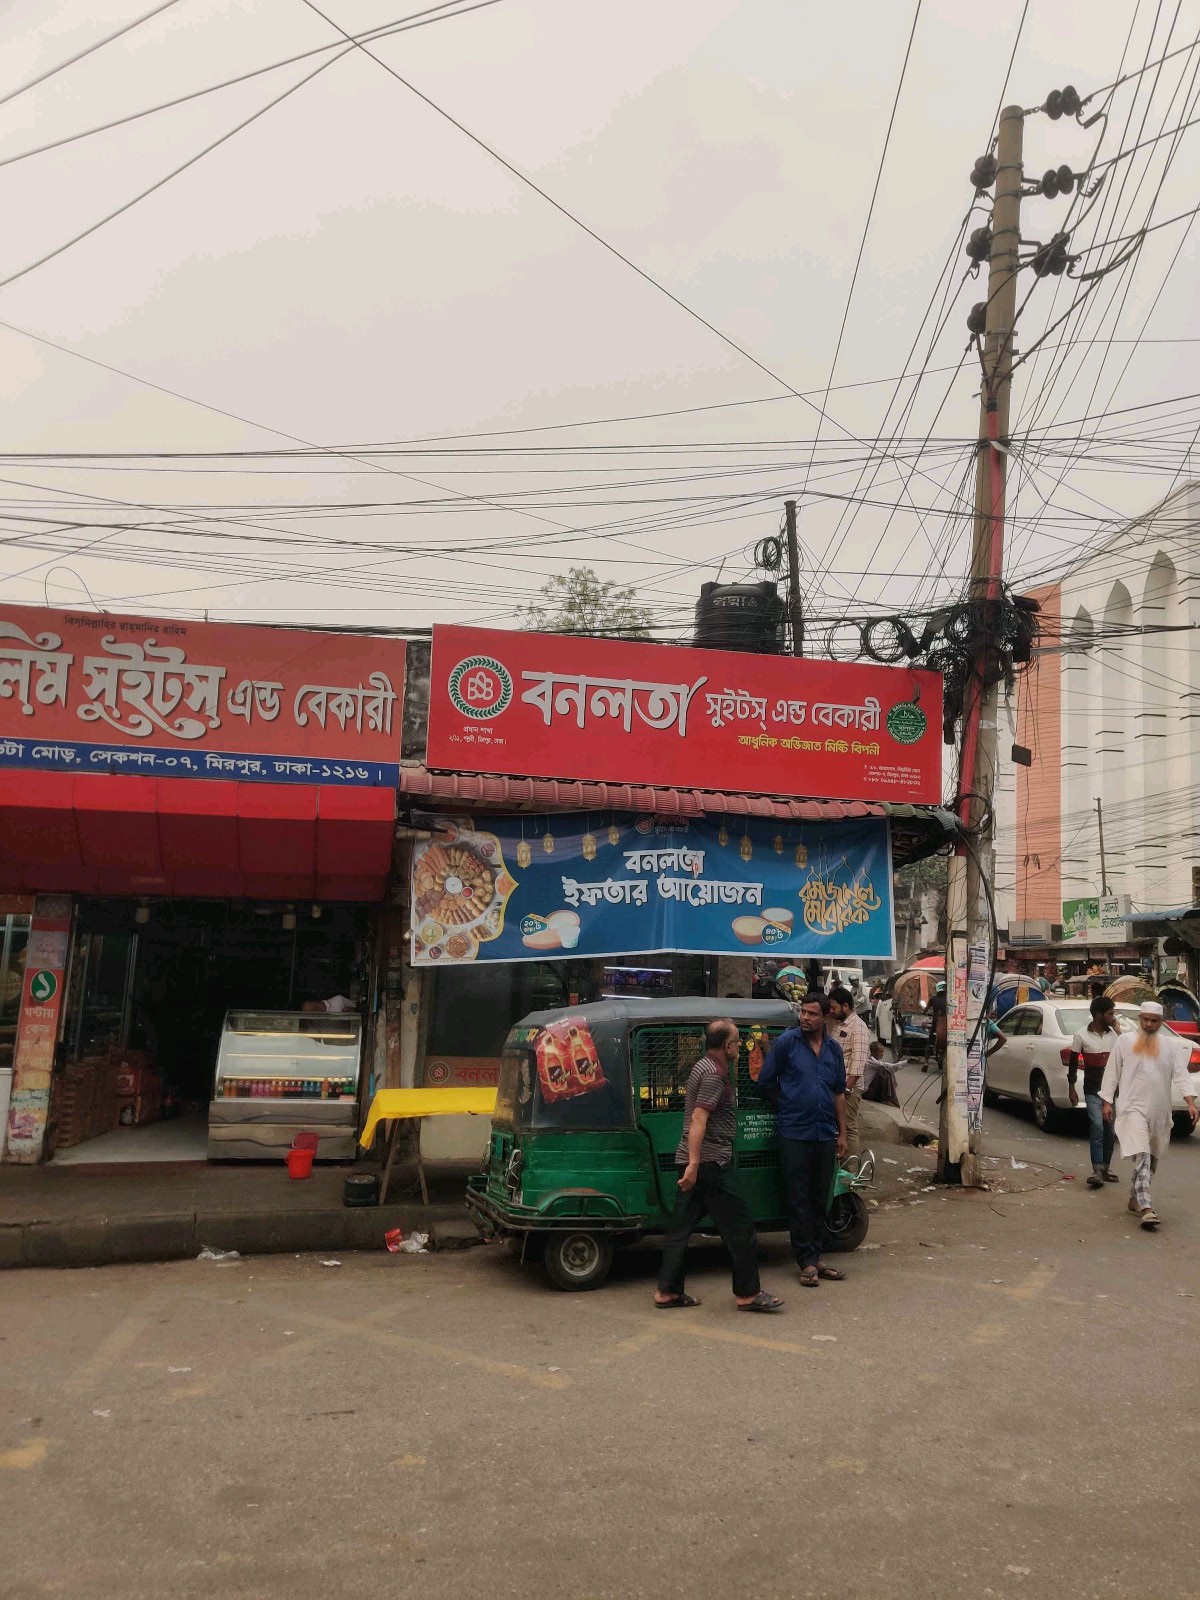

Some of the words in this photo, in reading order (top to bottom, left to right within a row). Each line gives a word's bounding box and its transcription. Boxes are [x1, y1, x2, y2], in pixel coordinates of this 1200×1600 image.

[227, 679, 286, 726] এন্ড
[294, 671, 398, 736] বেকারী
[521, 670, 709, 738] বনলতা
[772, 699, 808, 725] এন্ড
[811, 696, 882, 733] বেকারী
[738, 733, 779, 750] আধুনিক
[780, 736, 822, 751] অভিজাত
[825, 739, 849, 754] মিষ্টি
[32, 745, 82, 764] মোড়,
[90, 750, 198, 771] সেকশন-০৭,
[204, 753, 267, 775] মিরপুর,
[273, 760, 369, 780] ঢাকা-১২১৬
[561, 876, 649, 907] ইফতার
[656, 873, 764, 907] আয়োজন
